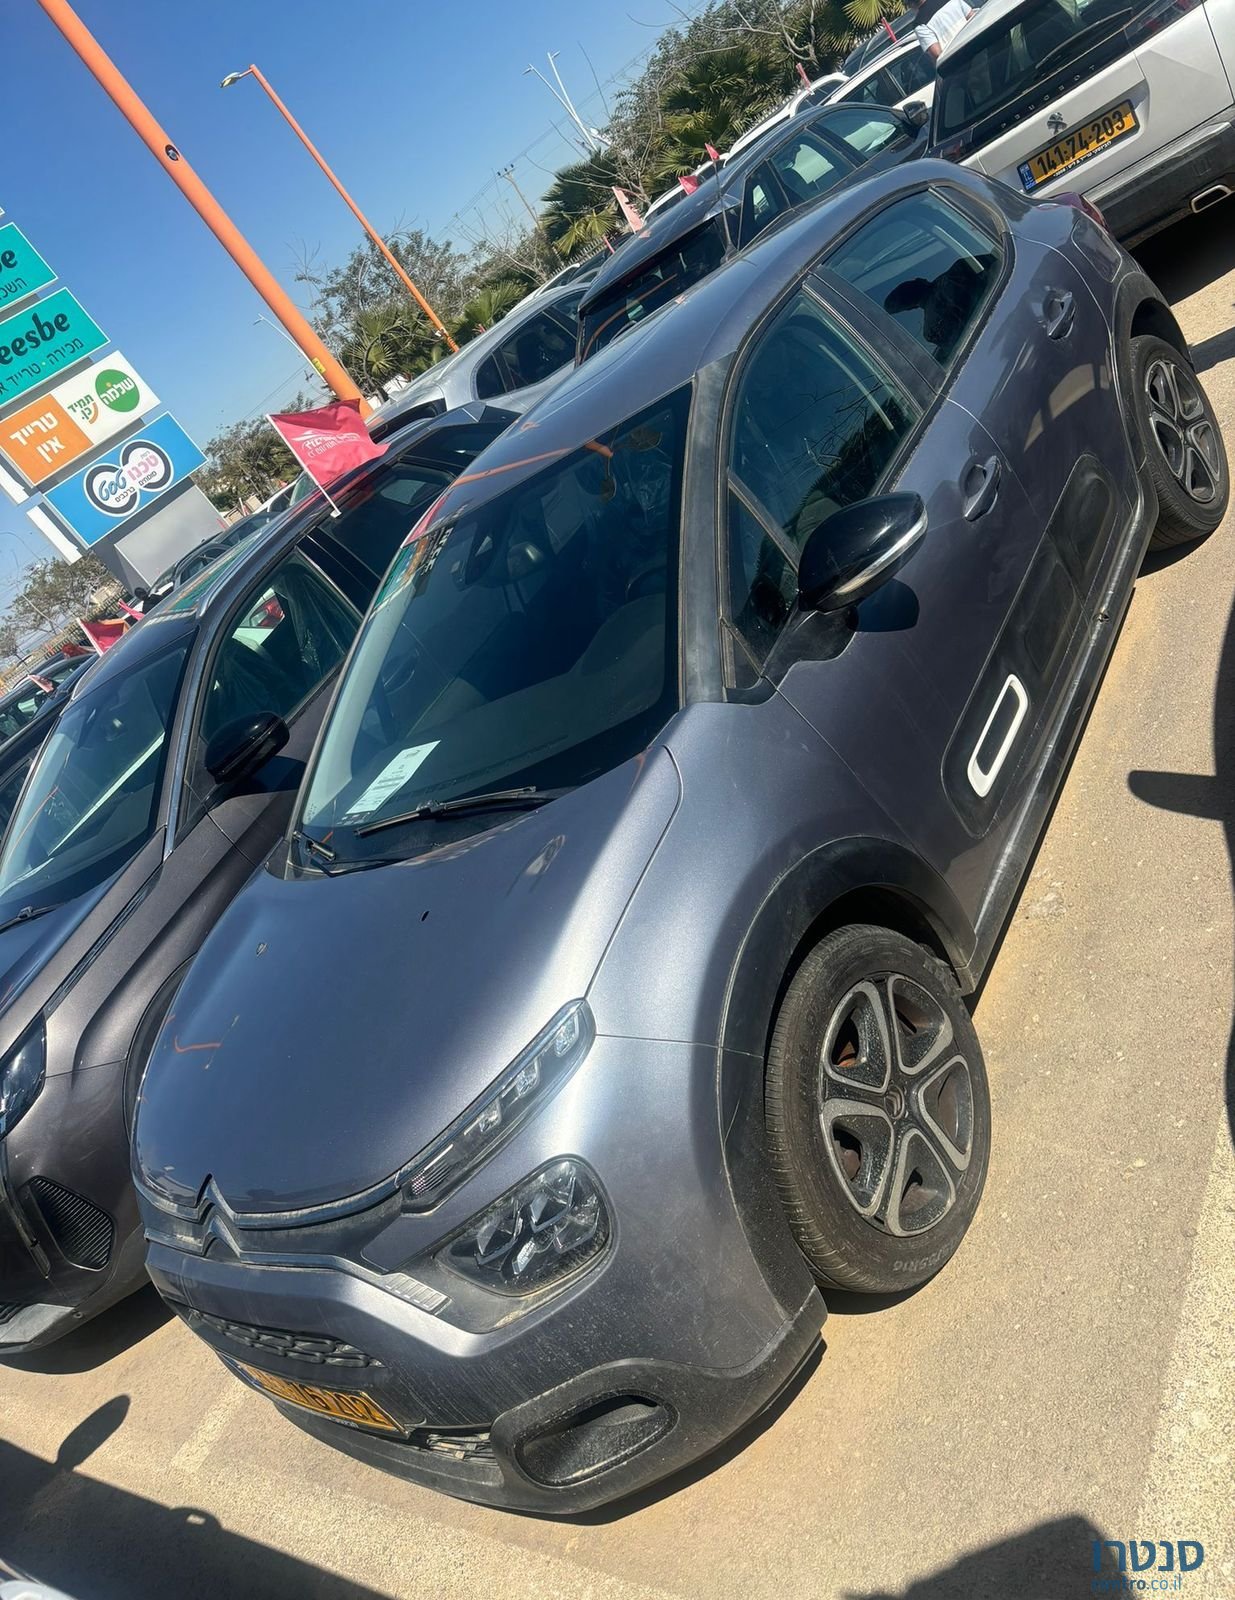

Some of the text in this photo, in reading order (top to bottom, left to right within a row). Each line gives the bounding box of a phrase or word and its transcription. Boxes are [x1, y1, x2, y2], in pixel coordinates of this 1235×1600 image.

[1001, 64, 1096, 129] PEUGEOT
[47, 337, 85, 366] מכירה
[6, 362, 41, 389] טרייד
[67, 393, 95, 414] תמיד
[100, 376, 136, 406] שלמה
[9, 411, 59, 447] טרייד
[35, 436, 66, 464] אין
[128, 453, 159, 482] טכנו
